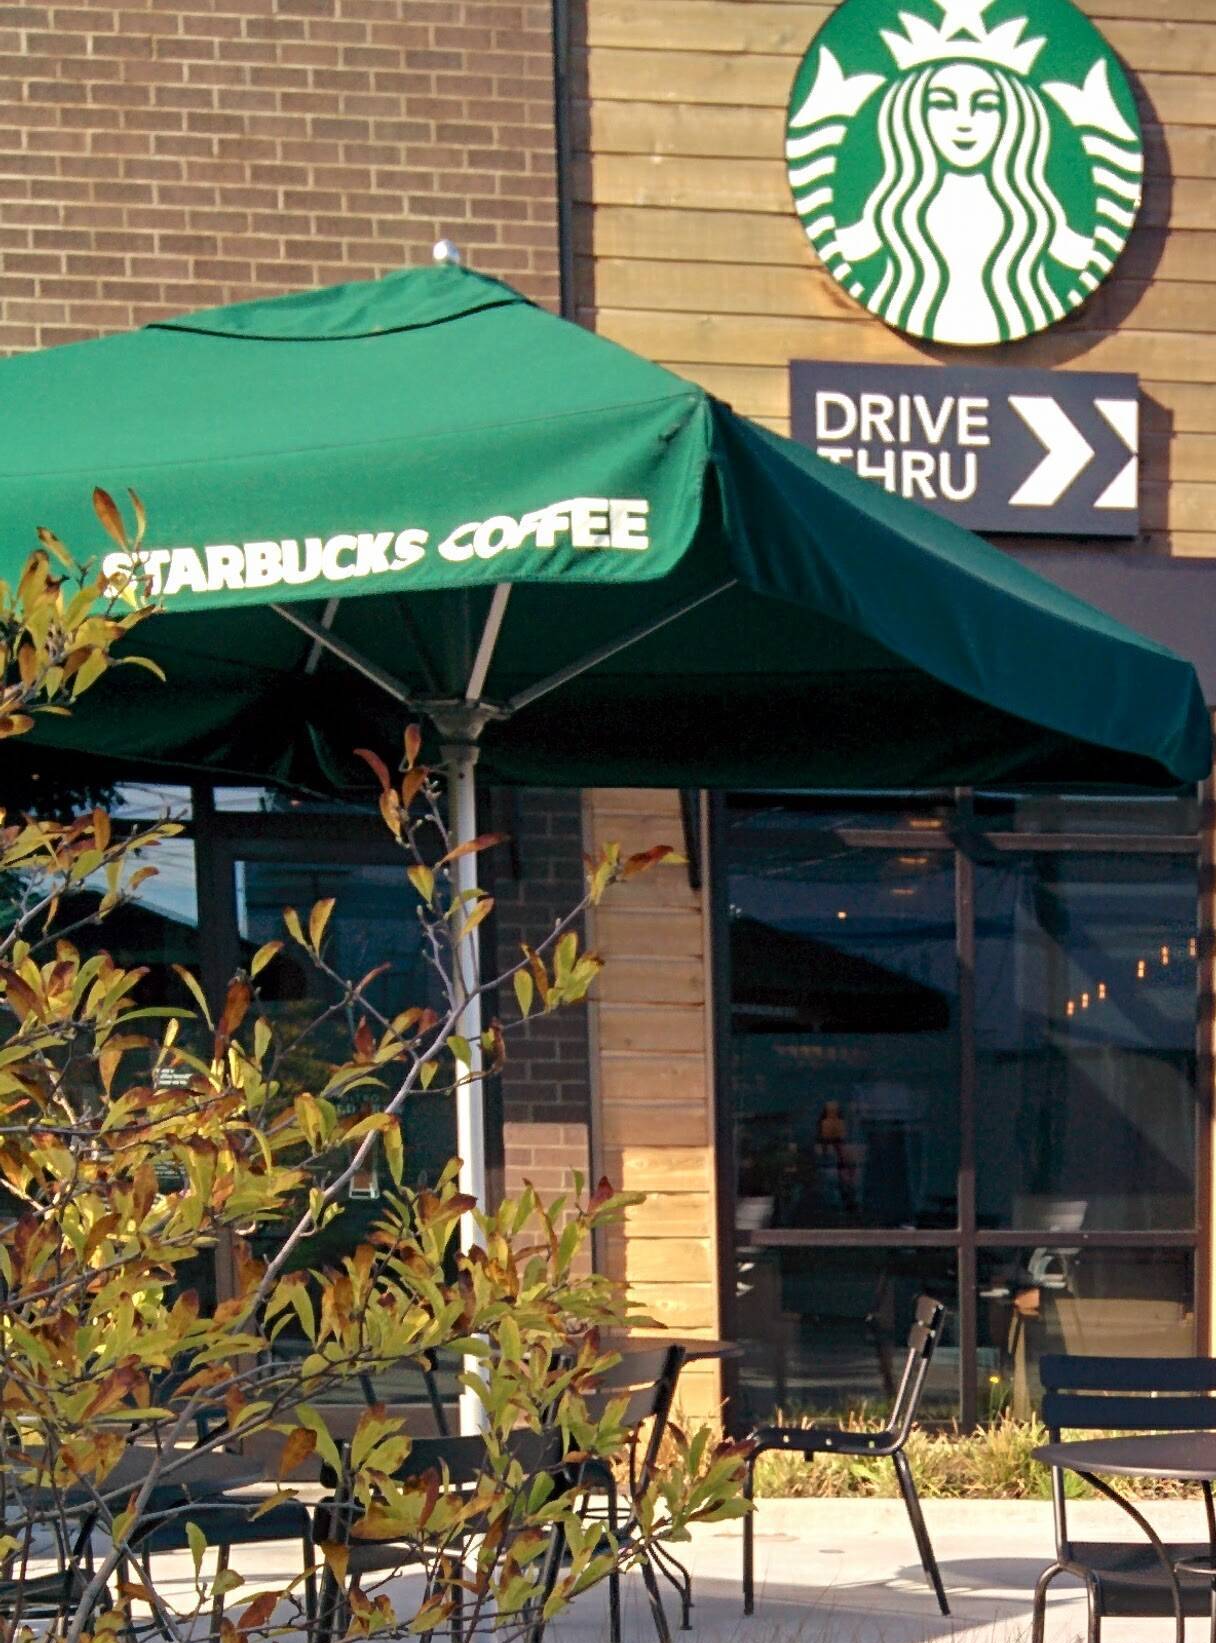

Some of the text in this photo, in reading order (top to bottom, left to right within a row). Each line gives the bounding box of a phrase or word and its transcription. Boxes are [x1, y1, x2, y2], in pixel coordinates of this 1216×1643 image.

[815, 391, 991, 446] DRIVE
[102, 497, 649, 600] STARBUCKS COFFEE
